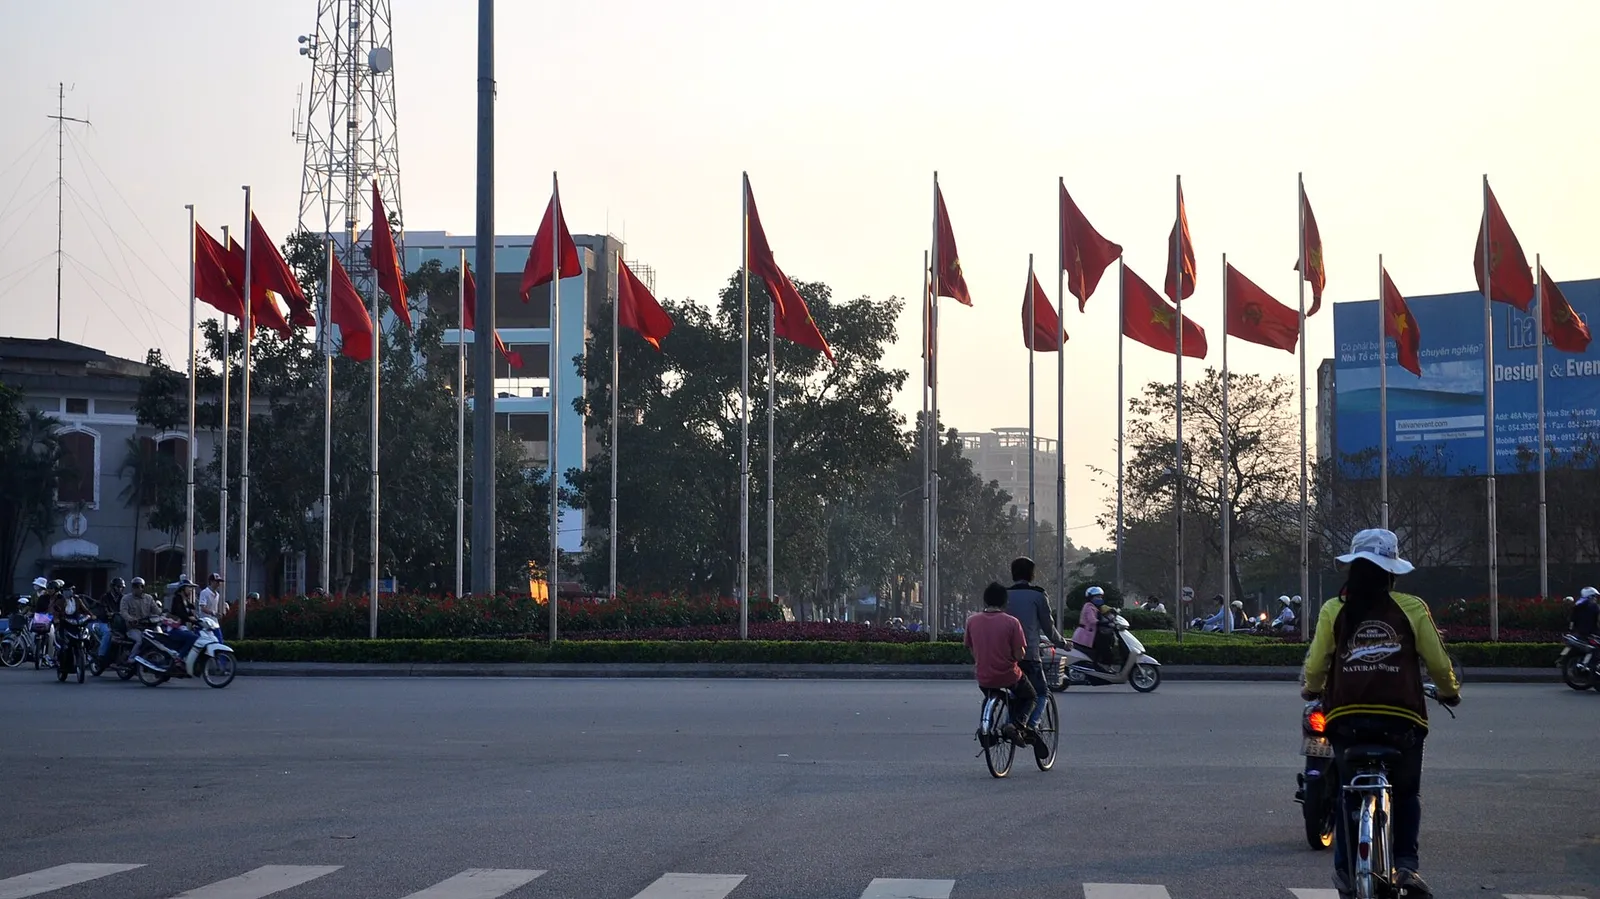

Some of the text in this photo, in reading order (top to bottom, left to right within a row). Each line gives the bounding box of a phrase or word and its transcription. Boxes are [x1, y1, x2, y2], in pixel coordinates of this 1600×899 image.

[1369, 351, 1389, 361] chc
[1550, 363, 1564, 378] &
[1342, 663, 1400, 672] NATURAL SPORT
